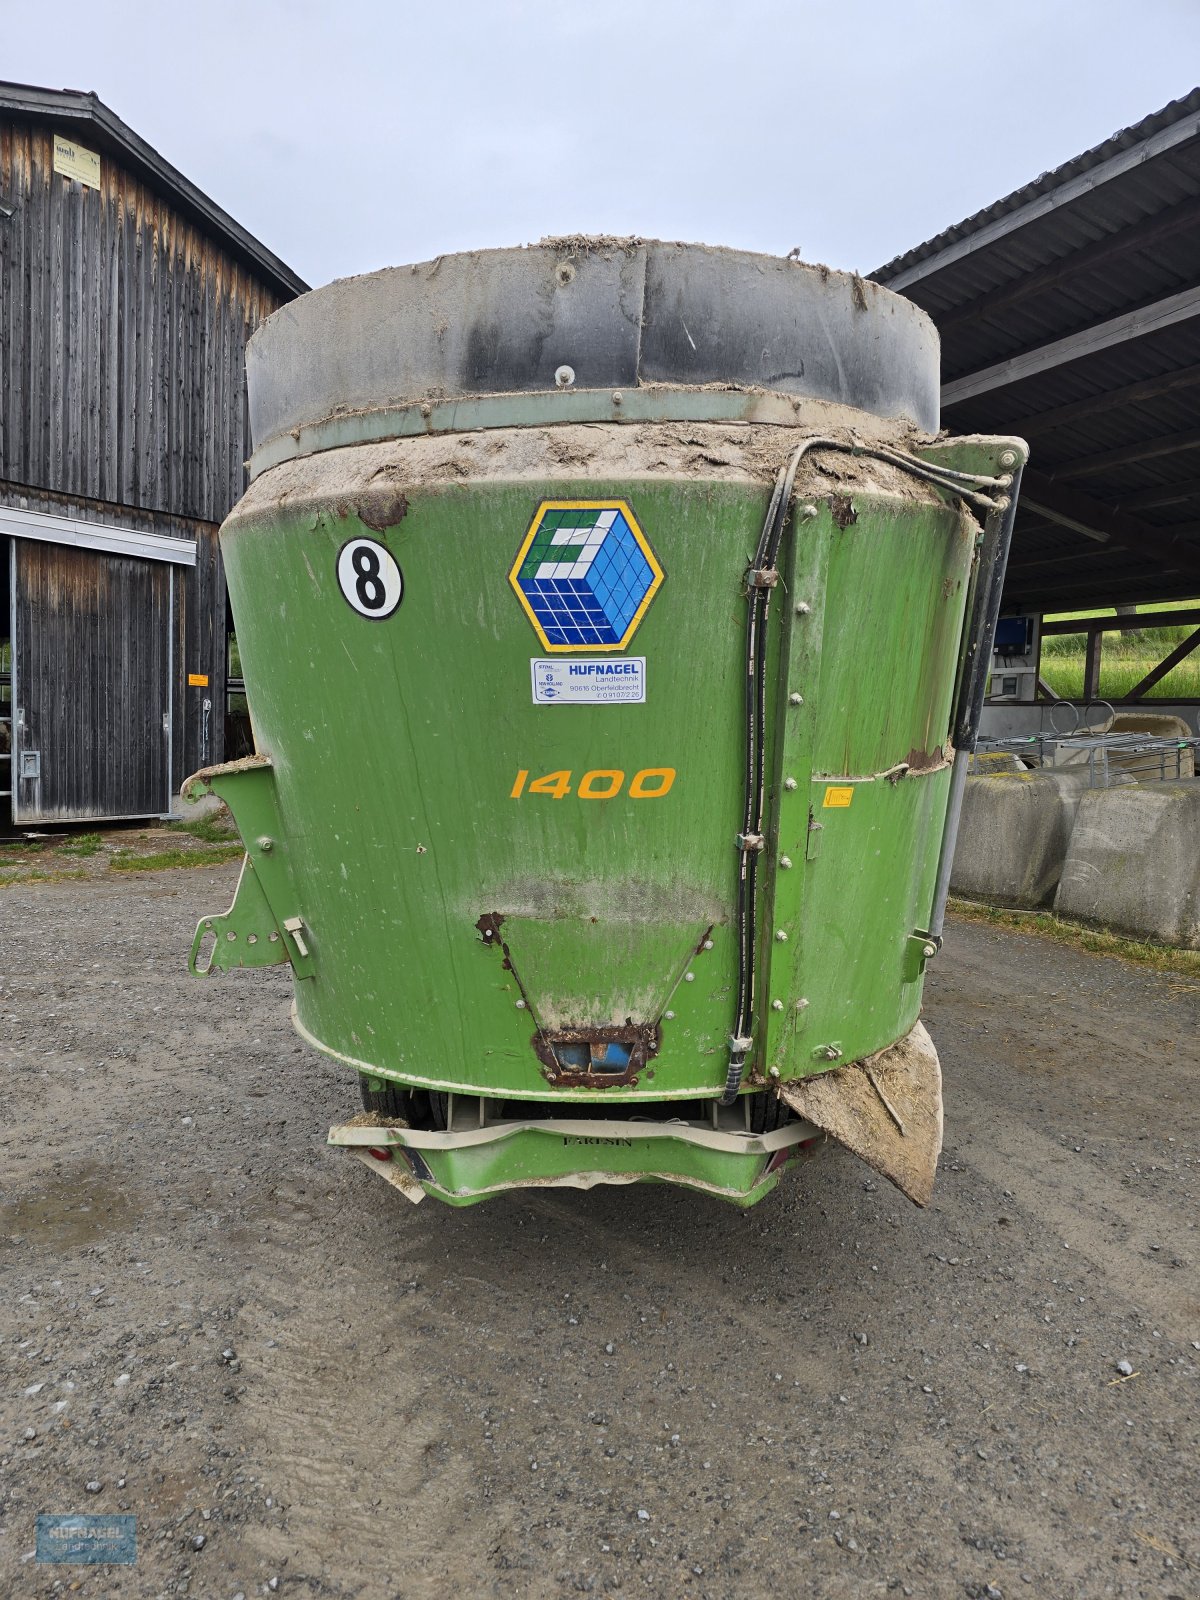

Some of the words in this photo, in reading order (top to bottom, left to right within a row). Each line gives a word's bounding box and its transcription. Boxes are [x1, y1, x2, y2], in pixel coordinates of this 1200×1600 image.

[352, 546, 386, 609] 8
[569, 664, 639, 675] HUFNAGEL
[510, 767, 676, 799] 1400
